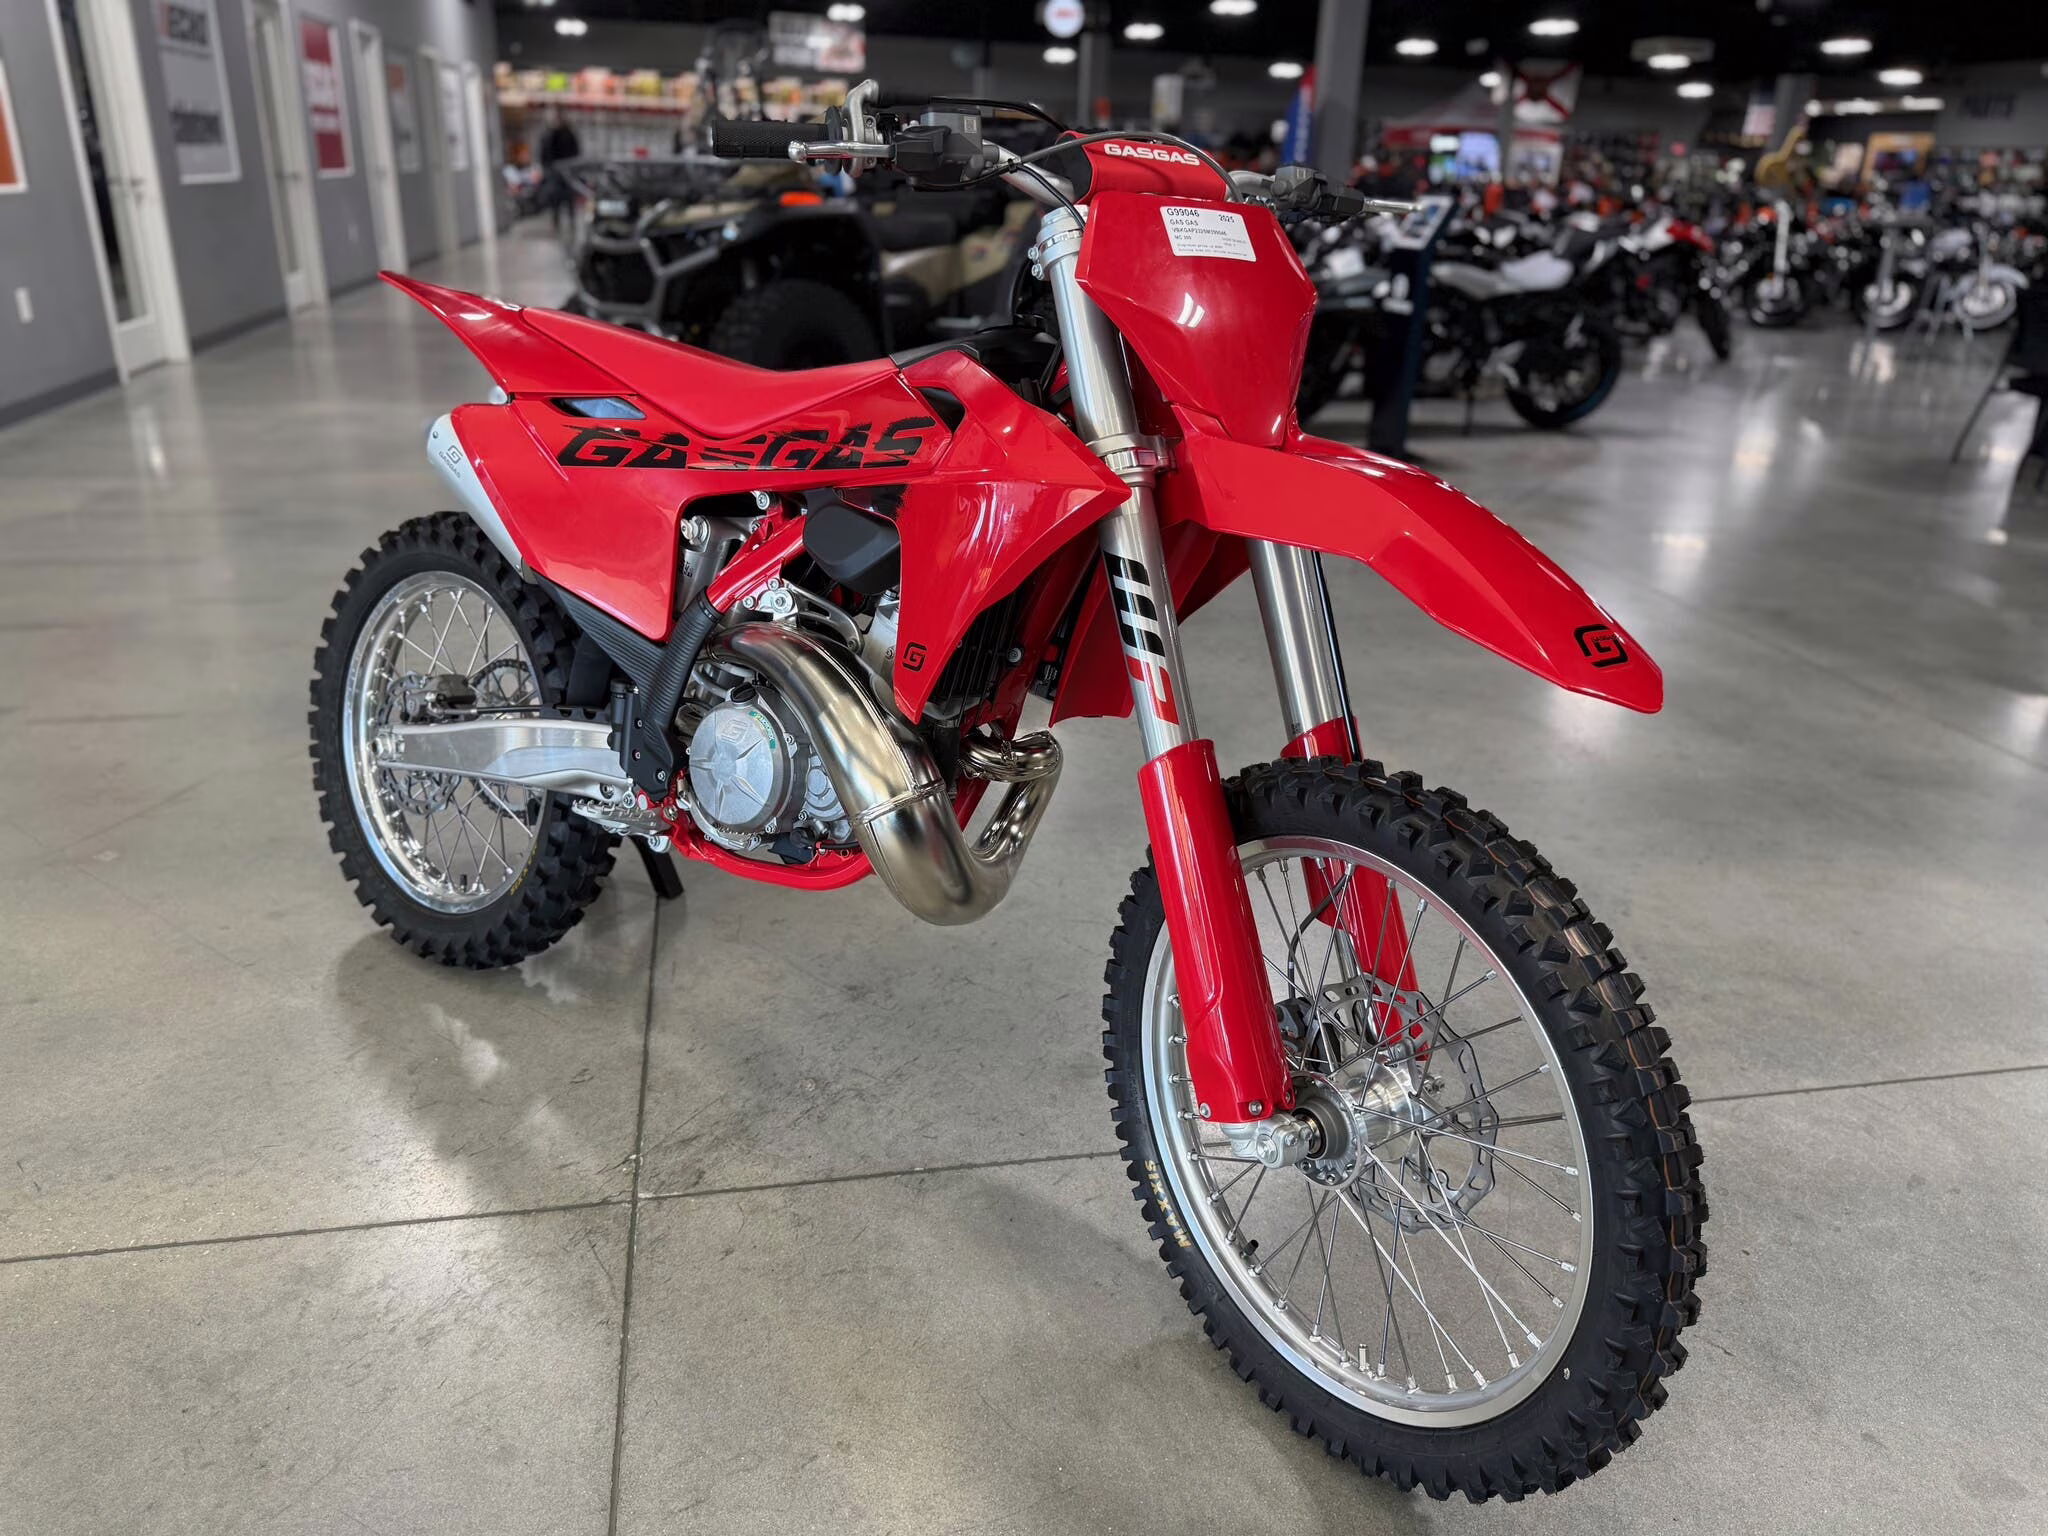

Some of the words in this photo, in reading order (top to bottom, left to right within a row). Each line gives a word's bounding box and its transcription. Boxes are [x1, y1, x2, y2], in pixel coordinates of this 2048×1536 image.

[1103, 143, 1201, 167] GASGAS
[1166, 207, 1200, 218] G99046
[1185, 219, 1199, 227] GAS
[559, 416, 936, 471] GASGAS
[1103, 550, 1180, 726] WP
[1144, 1159, 1192, 1248] MAXXIS
